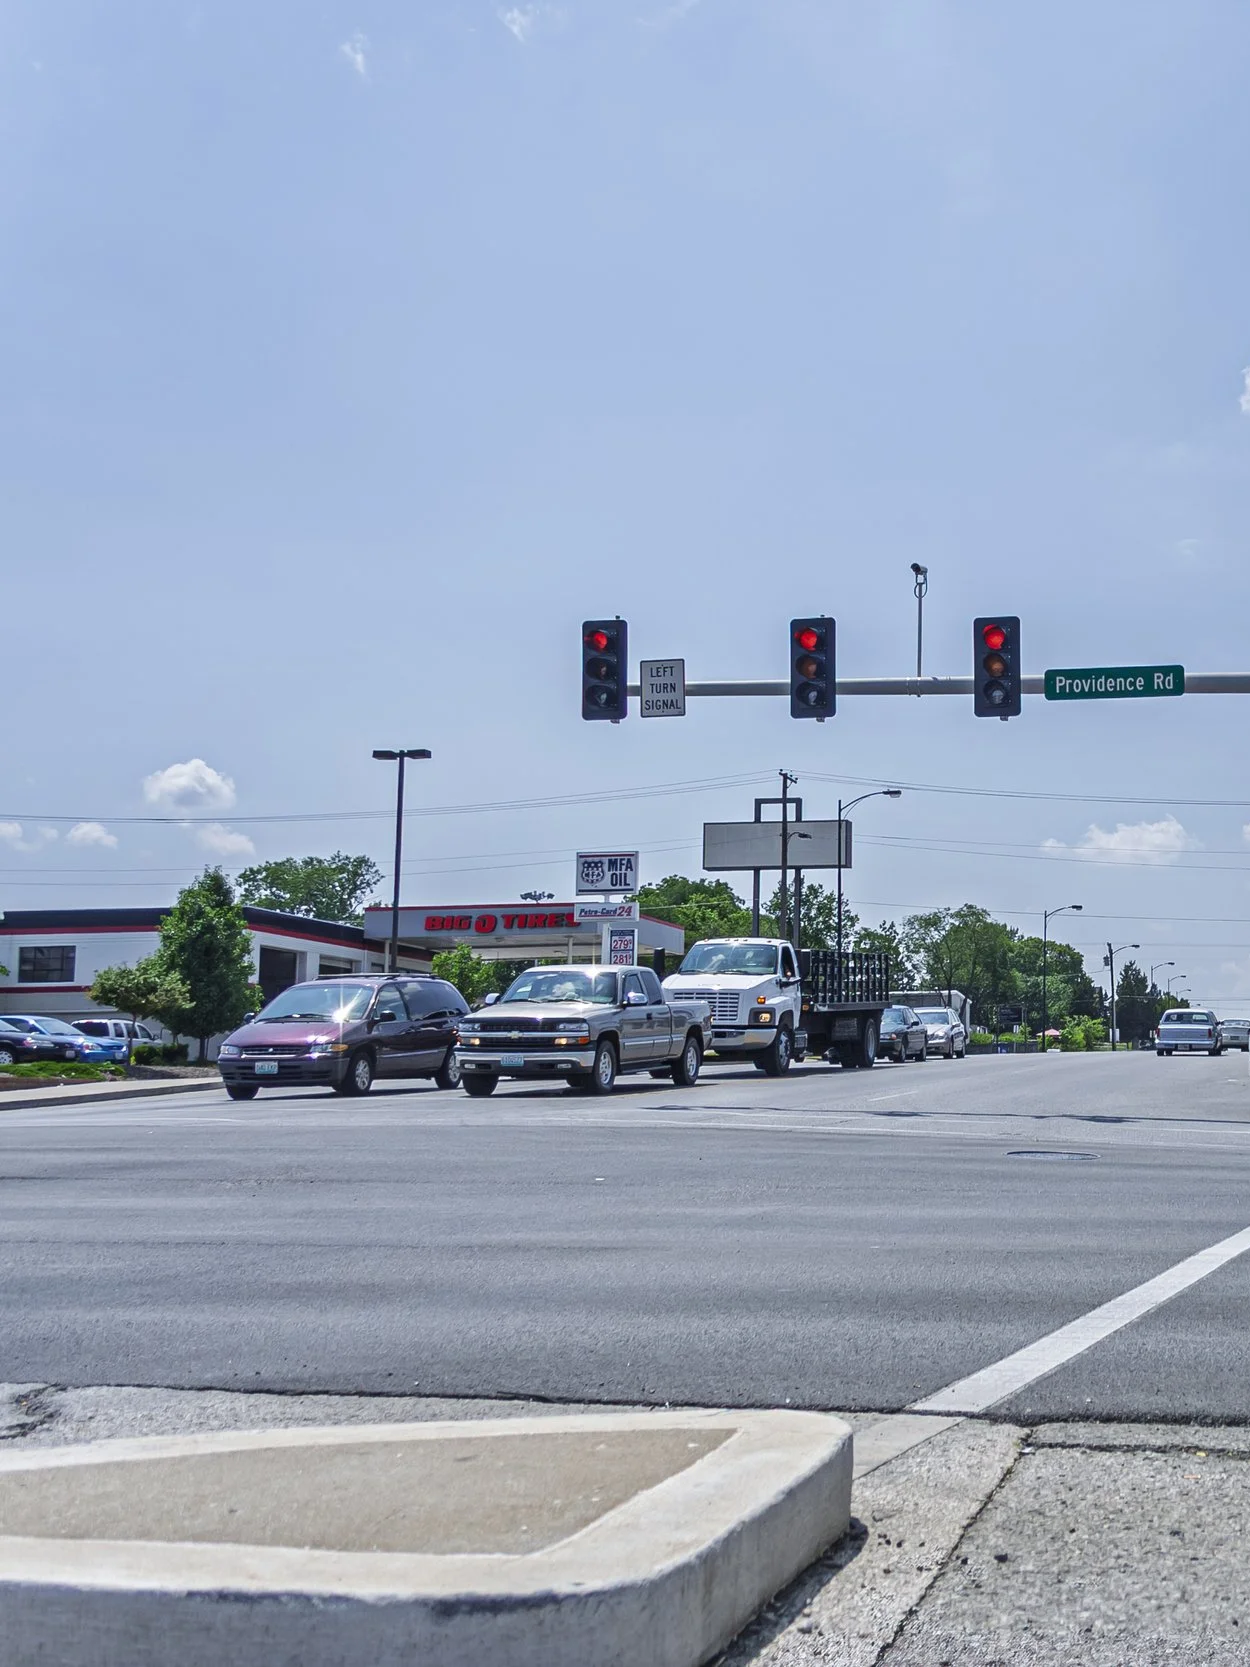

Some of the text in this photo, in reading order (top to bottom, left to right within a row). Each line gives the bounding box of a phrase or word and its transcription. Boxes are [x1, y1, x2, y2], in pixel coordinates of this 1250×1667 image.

[650, 666, 675, 678] LEFT
[649, 683, 676, 694] TURN
[1055, 672, 1174, 693] Providence Rd
[644, 699, 682, 710] SIGNAL
[607, 858, 633, 872] MFA
[610, 873, 630, 887] OIL
[617, 905, 632, 916] 24
[424, 912, 582, 934] BIG O TIRES
